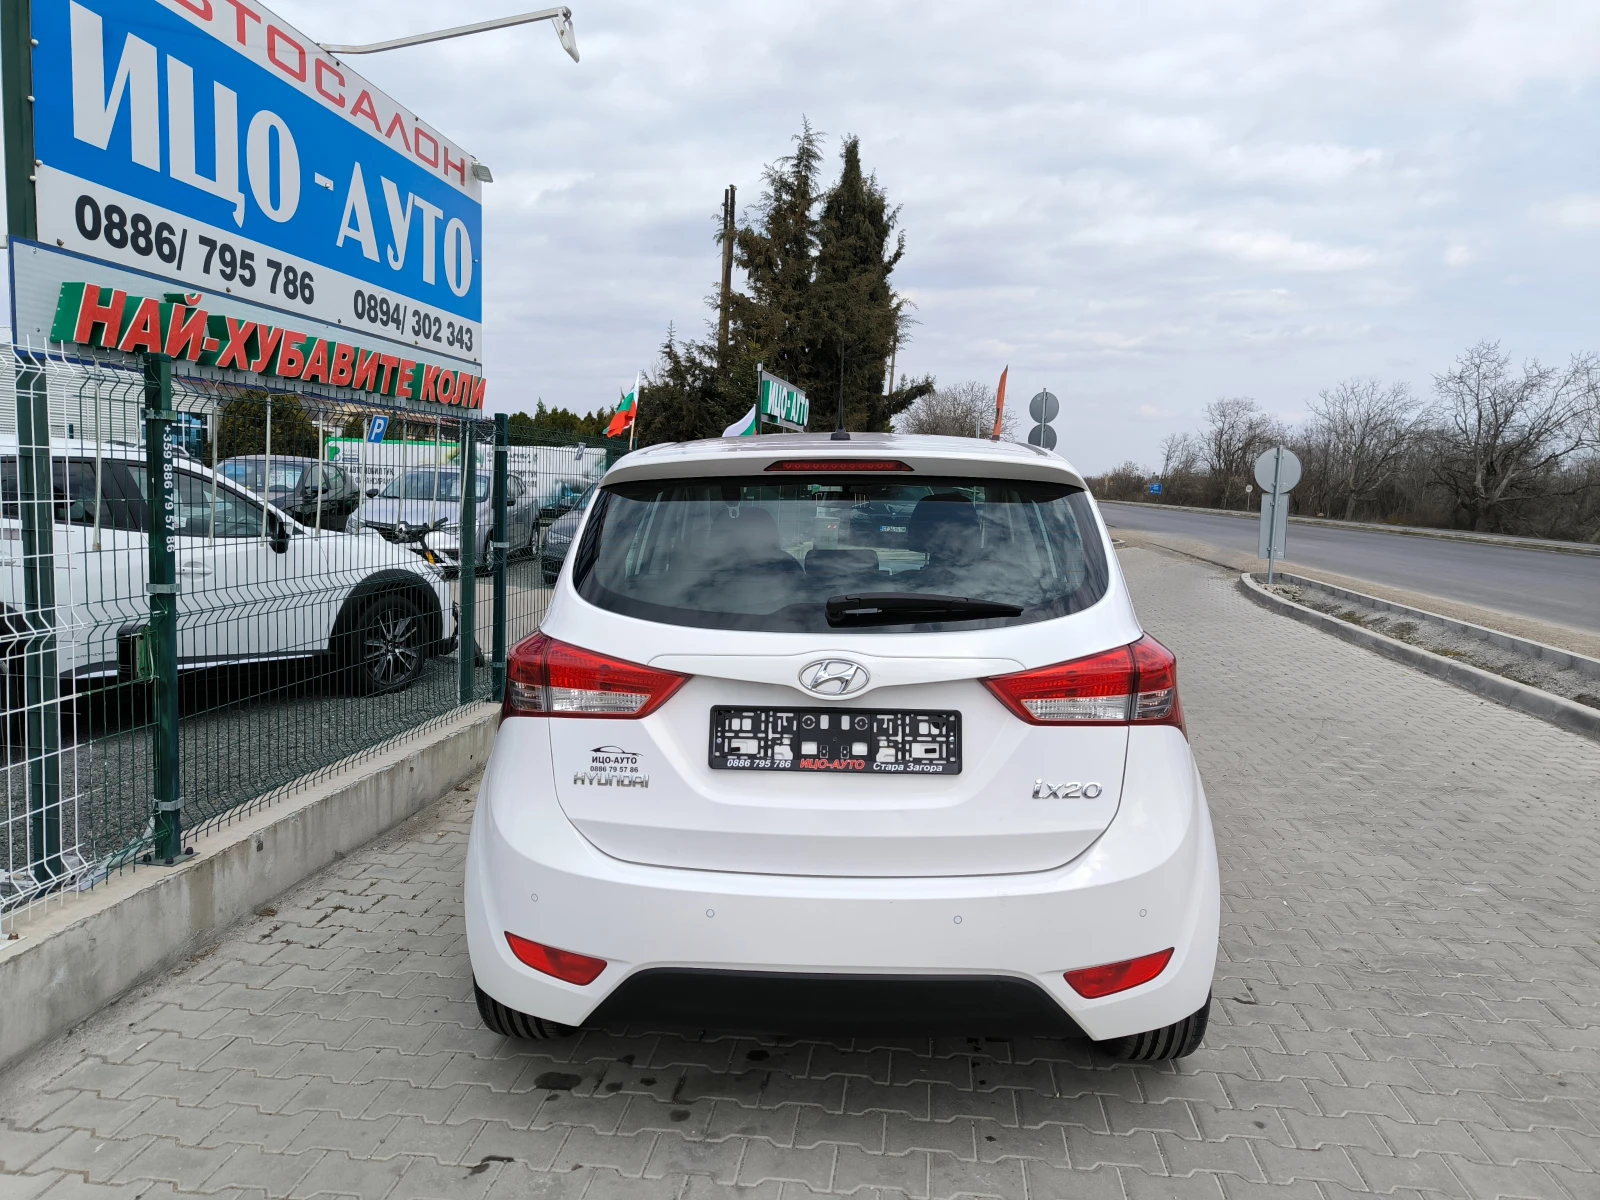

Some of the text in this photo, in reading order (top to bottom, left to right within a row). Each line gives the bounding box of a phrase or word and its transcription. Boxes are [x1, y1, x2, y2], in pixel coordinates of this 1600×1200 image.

[75, 195, 315, 305] 0886/ 795 786
[353, 289, 473, 352] 0894/ 302 343
[72, 282, 487, 410] НАЙ-ХУБАВИТЕ КОЛИ
[163, 424, 176, 552] +359 886 79 57 86
[591, 756, 637, 765] ИЦО-АУТО
[727, 759, 792, 769] 0886 795 786
[799, 758, 866, 770] ИЦО-АУТО
[872, 762, 943, 772] Стара Загора
[590, 765, 607, 773] 0886
[573, 772, 650, 788] HYUNDAI
[1032, 778, 1103, 800] ix20
